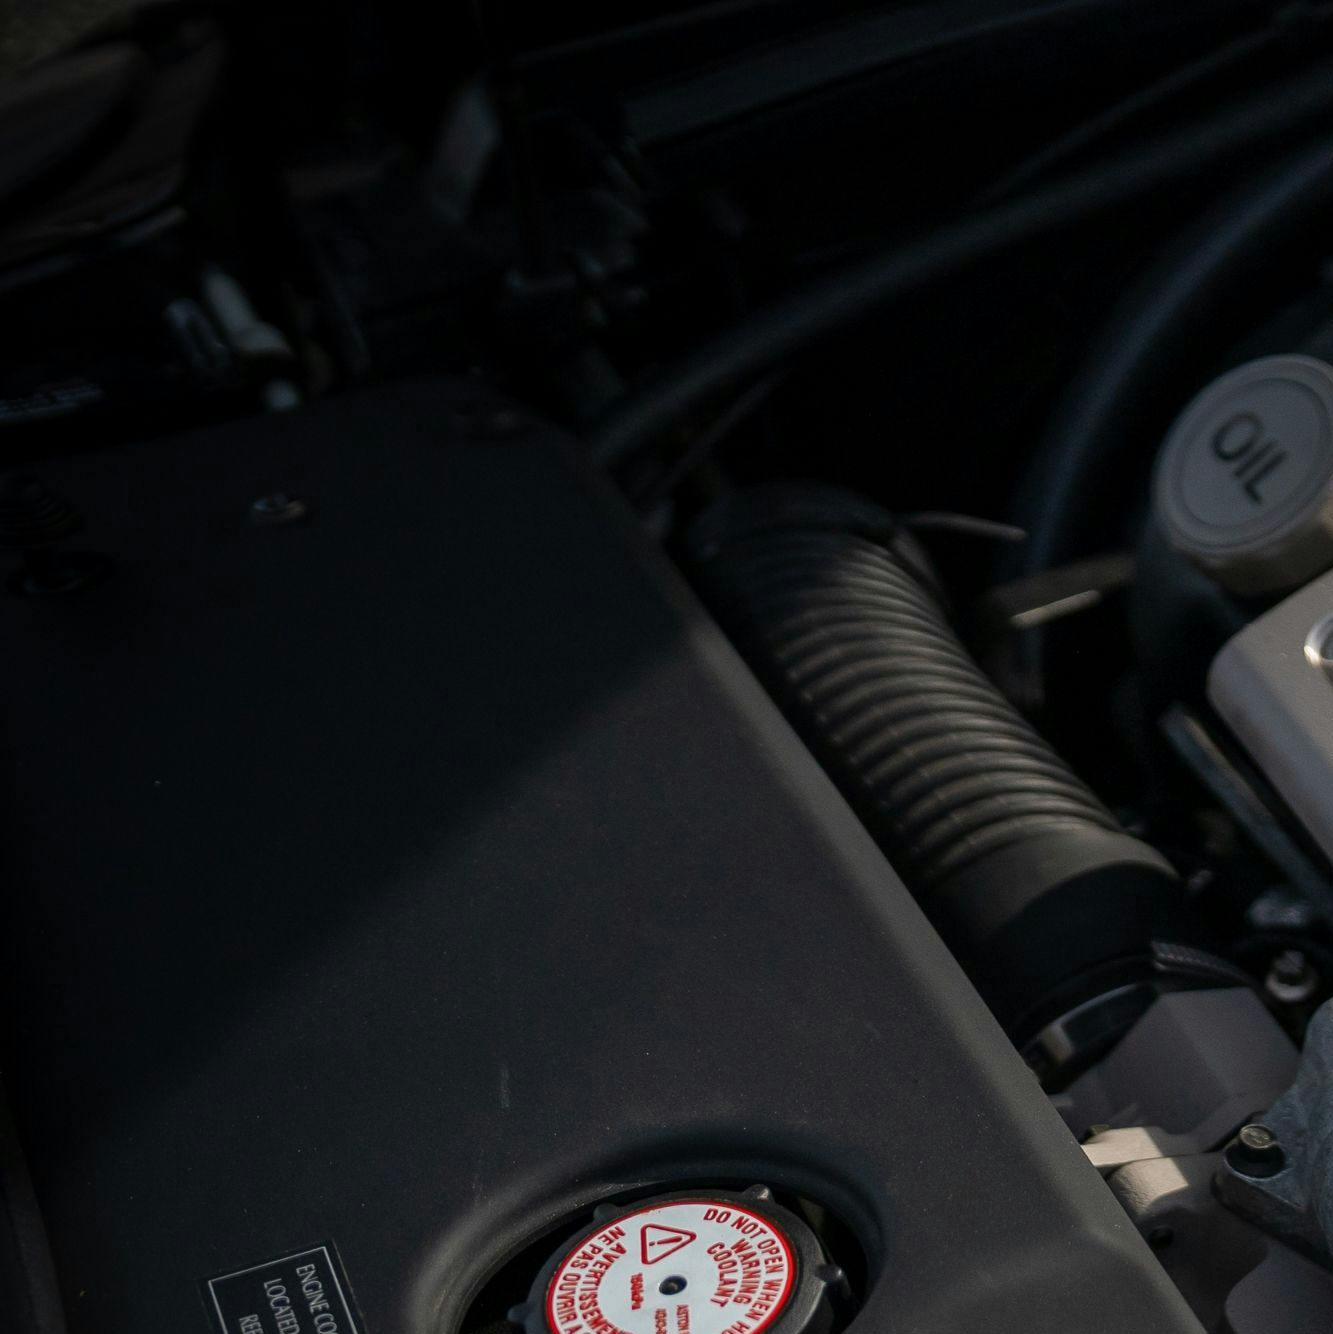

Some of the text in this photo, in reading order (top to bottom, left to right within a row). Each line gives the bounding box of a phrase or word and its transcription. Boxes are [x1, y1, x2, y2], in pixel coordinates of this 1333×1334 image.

[1210, 411, 1289, 505] OIL
[599, 1226, 627, 1246] NE
[702, 1207, 731, 1224] DO
[731, 1215, 768, 1240] NOT
[570, 1243, 600, 1270] PAS
[706, 1241, 738, 1308] COOLANT
[730, 1238, 762, 1305] WARNING
[757, 1237, 784, 1274] OPEN
[295, 1263, 331, 1313] ENGINE
[556, 1272, 581, 1325] OUVRIR
[745, 1278, 784, 1321] WHEN
